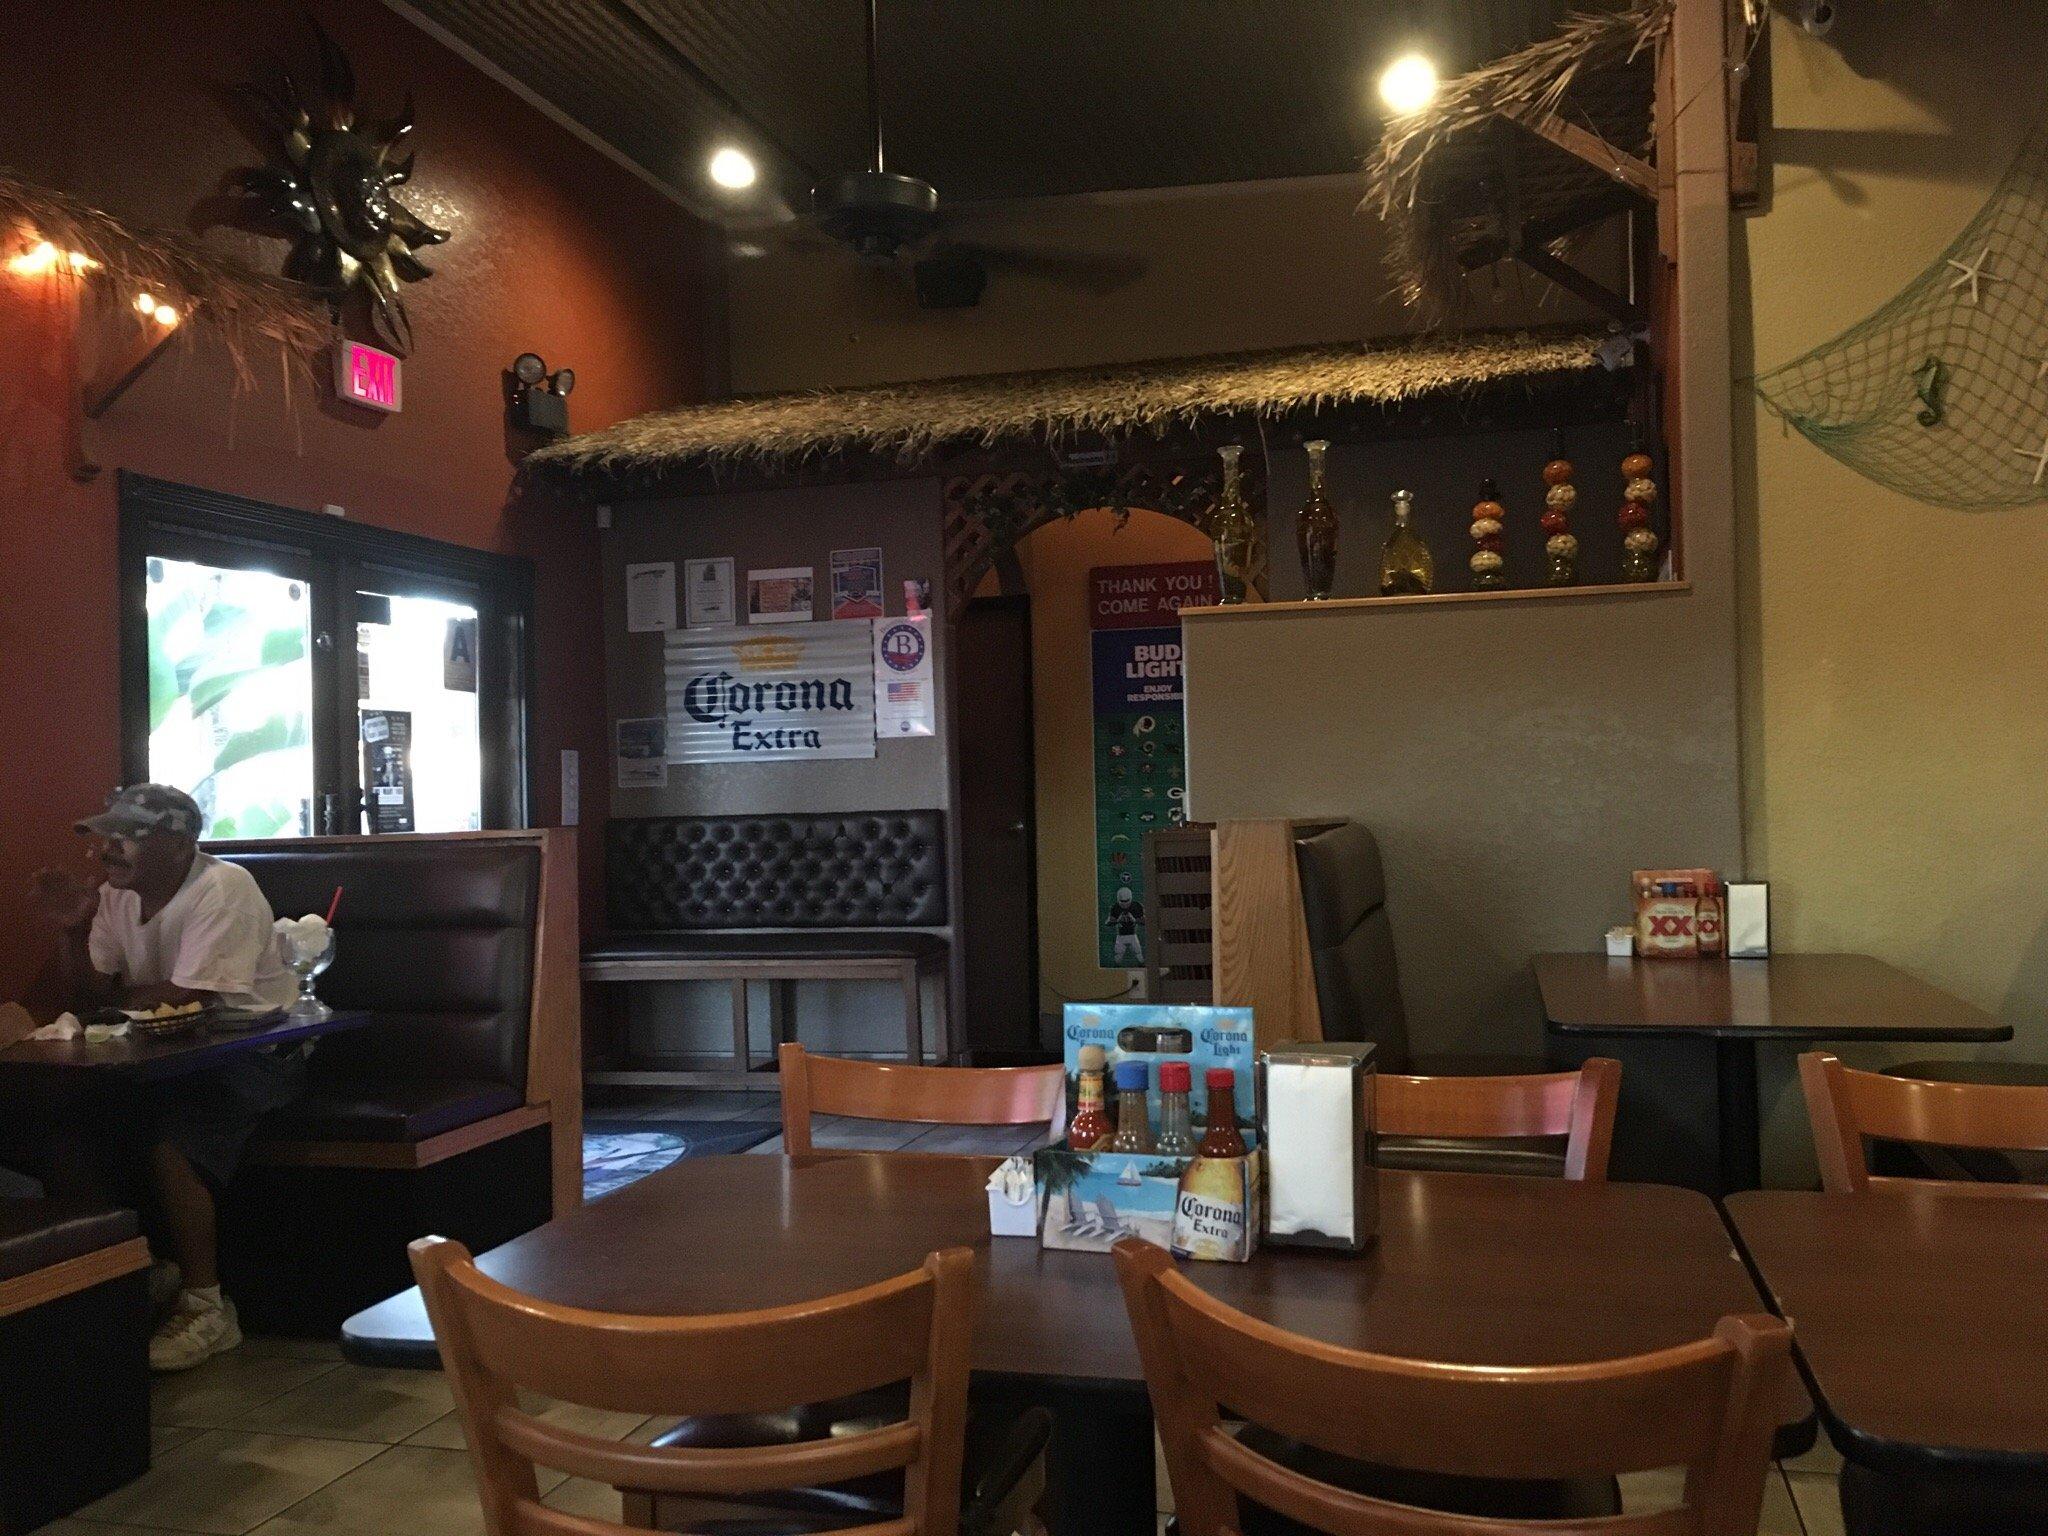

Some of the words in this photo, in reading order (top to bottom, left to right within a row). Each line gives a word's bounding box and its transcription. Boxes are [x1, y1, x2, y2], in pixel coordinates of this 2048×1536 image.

[1097, 577, 1158, 594] THANK
[1164, 574, 1202, 591] YOU
[1098, 597, 1151, 615] COME
[1157, 594, 1214, 611] AGAIN
[450, 626, 470, 663] A
[895, 634, 912, 655] B
[1134, 644, 1181, 662] BUD
[1143, 684, 1173, 693] ENJOY
[684, 671, 855, 728] Corona
[732, 719, 822, 750] Extra
[1648, 916, 1693, 936] XX
[1067, 1024, 1115, 1041] Corona
[1200, 1028, 1248, 1046] Corona
[1213, 1044, 1241, 1057] Light
[1181, 1196, 1241, 1225] Corona
[1193, 1218, 1228, 1238] Extra
